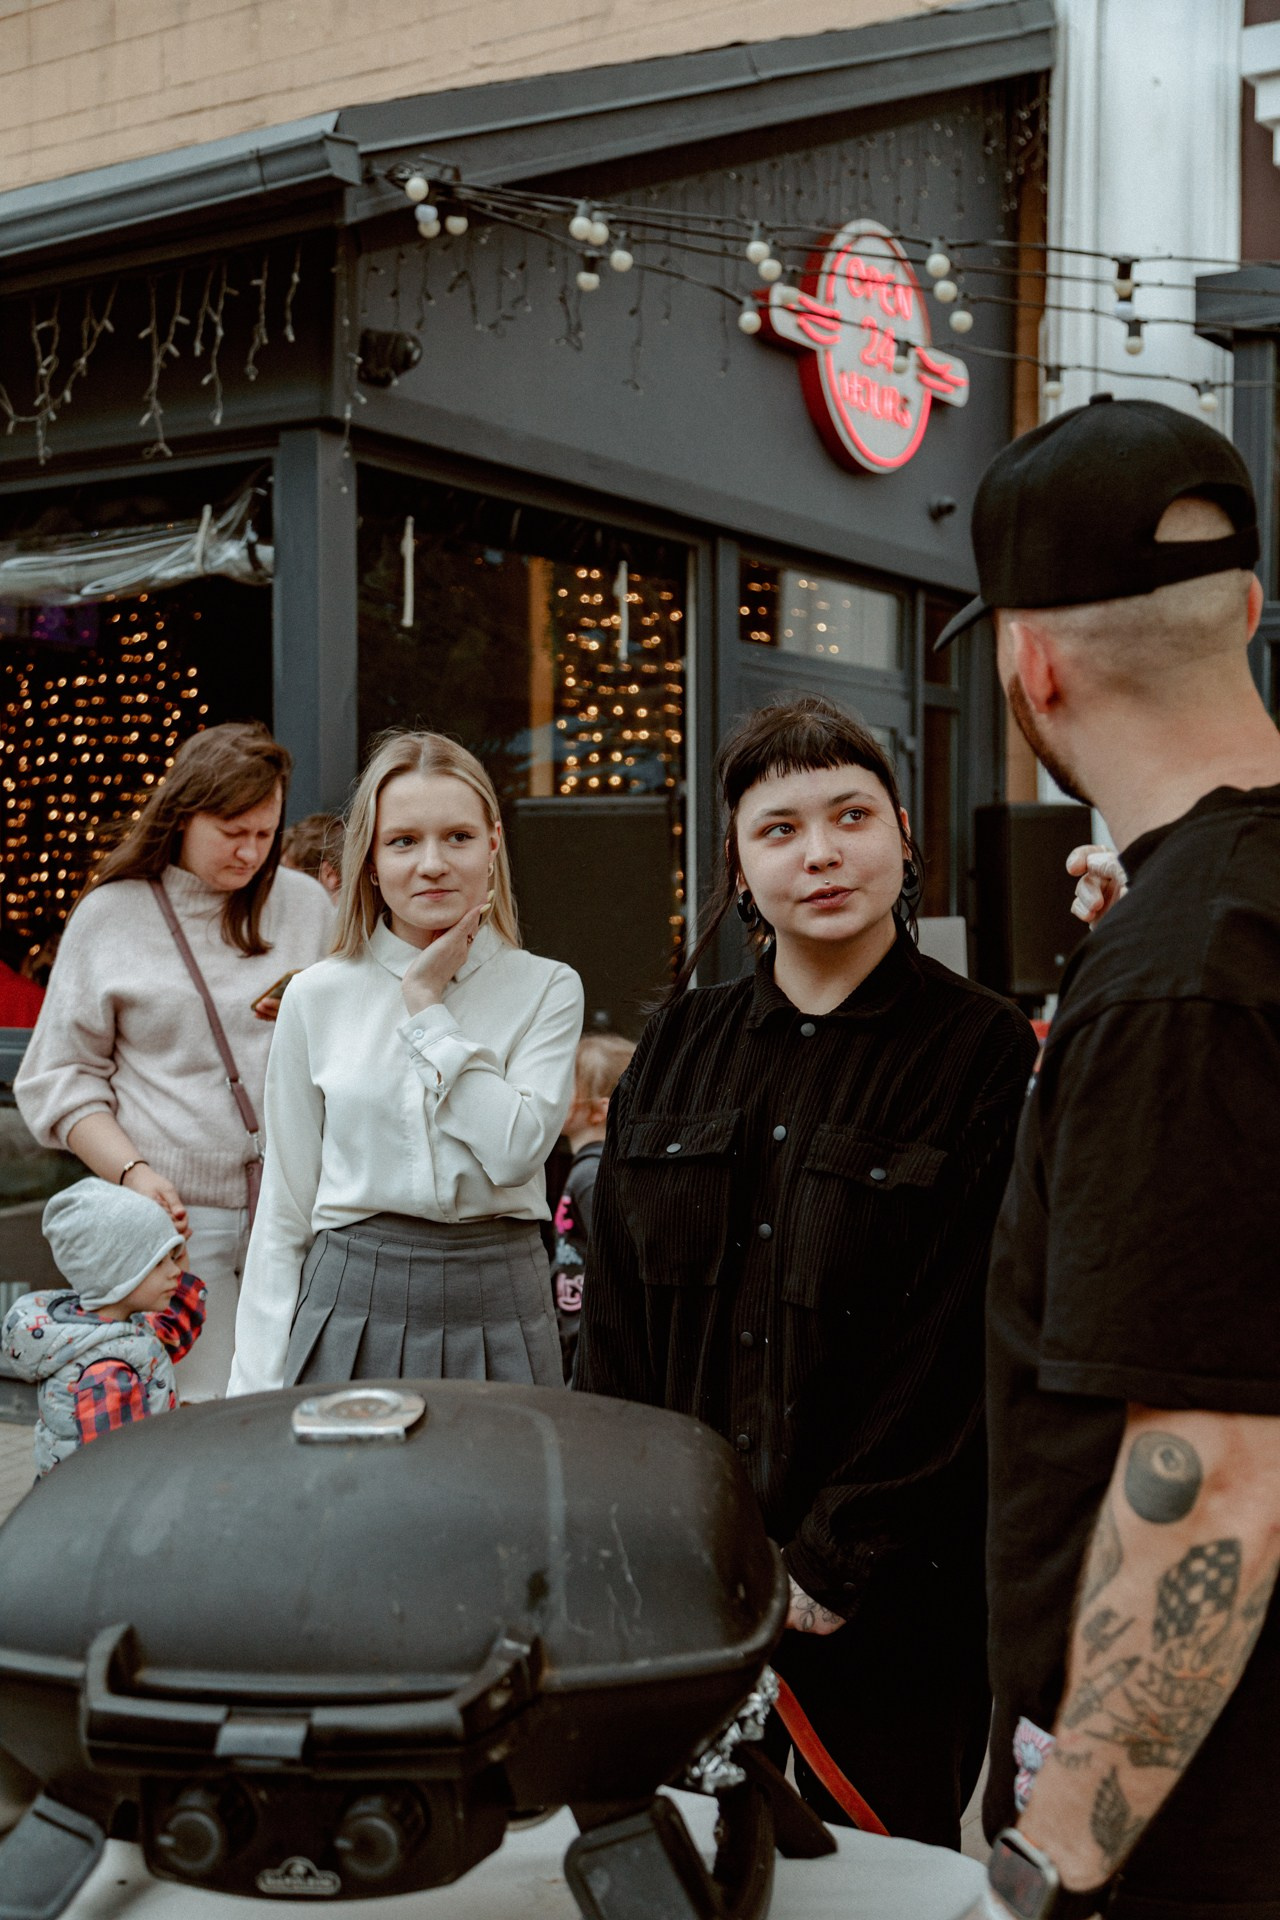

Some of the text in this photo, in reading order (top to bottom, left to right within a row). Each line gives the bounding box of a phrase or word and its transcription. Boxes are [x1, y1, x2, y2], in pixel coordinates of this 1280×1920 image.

[847, 257, 912, 320] OPEN
[859, 316, 895, 373] 24
[840, 371, 912, 429] HOURS
